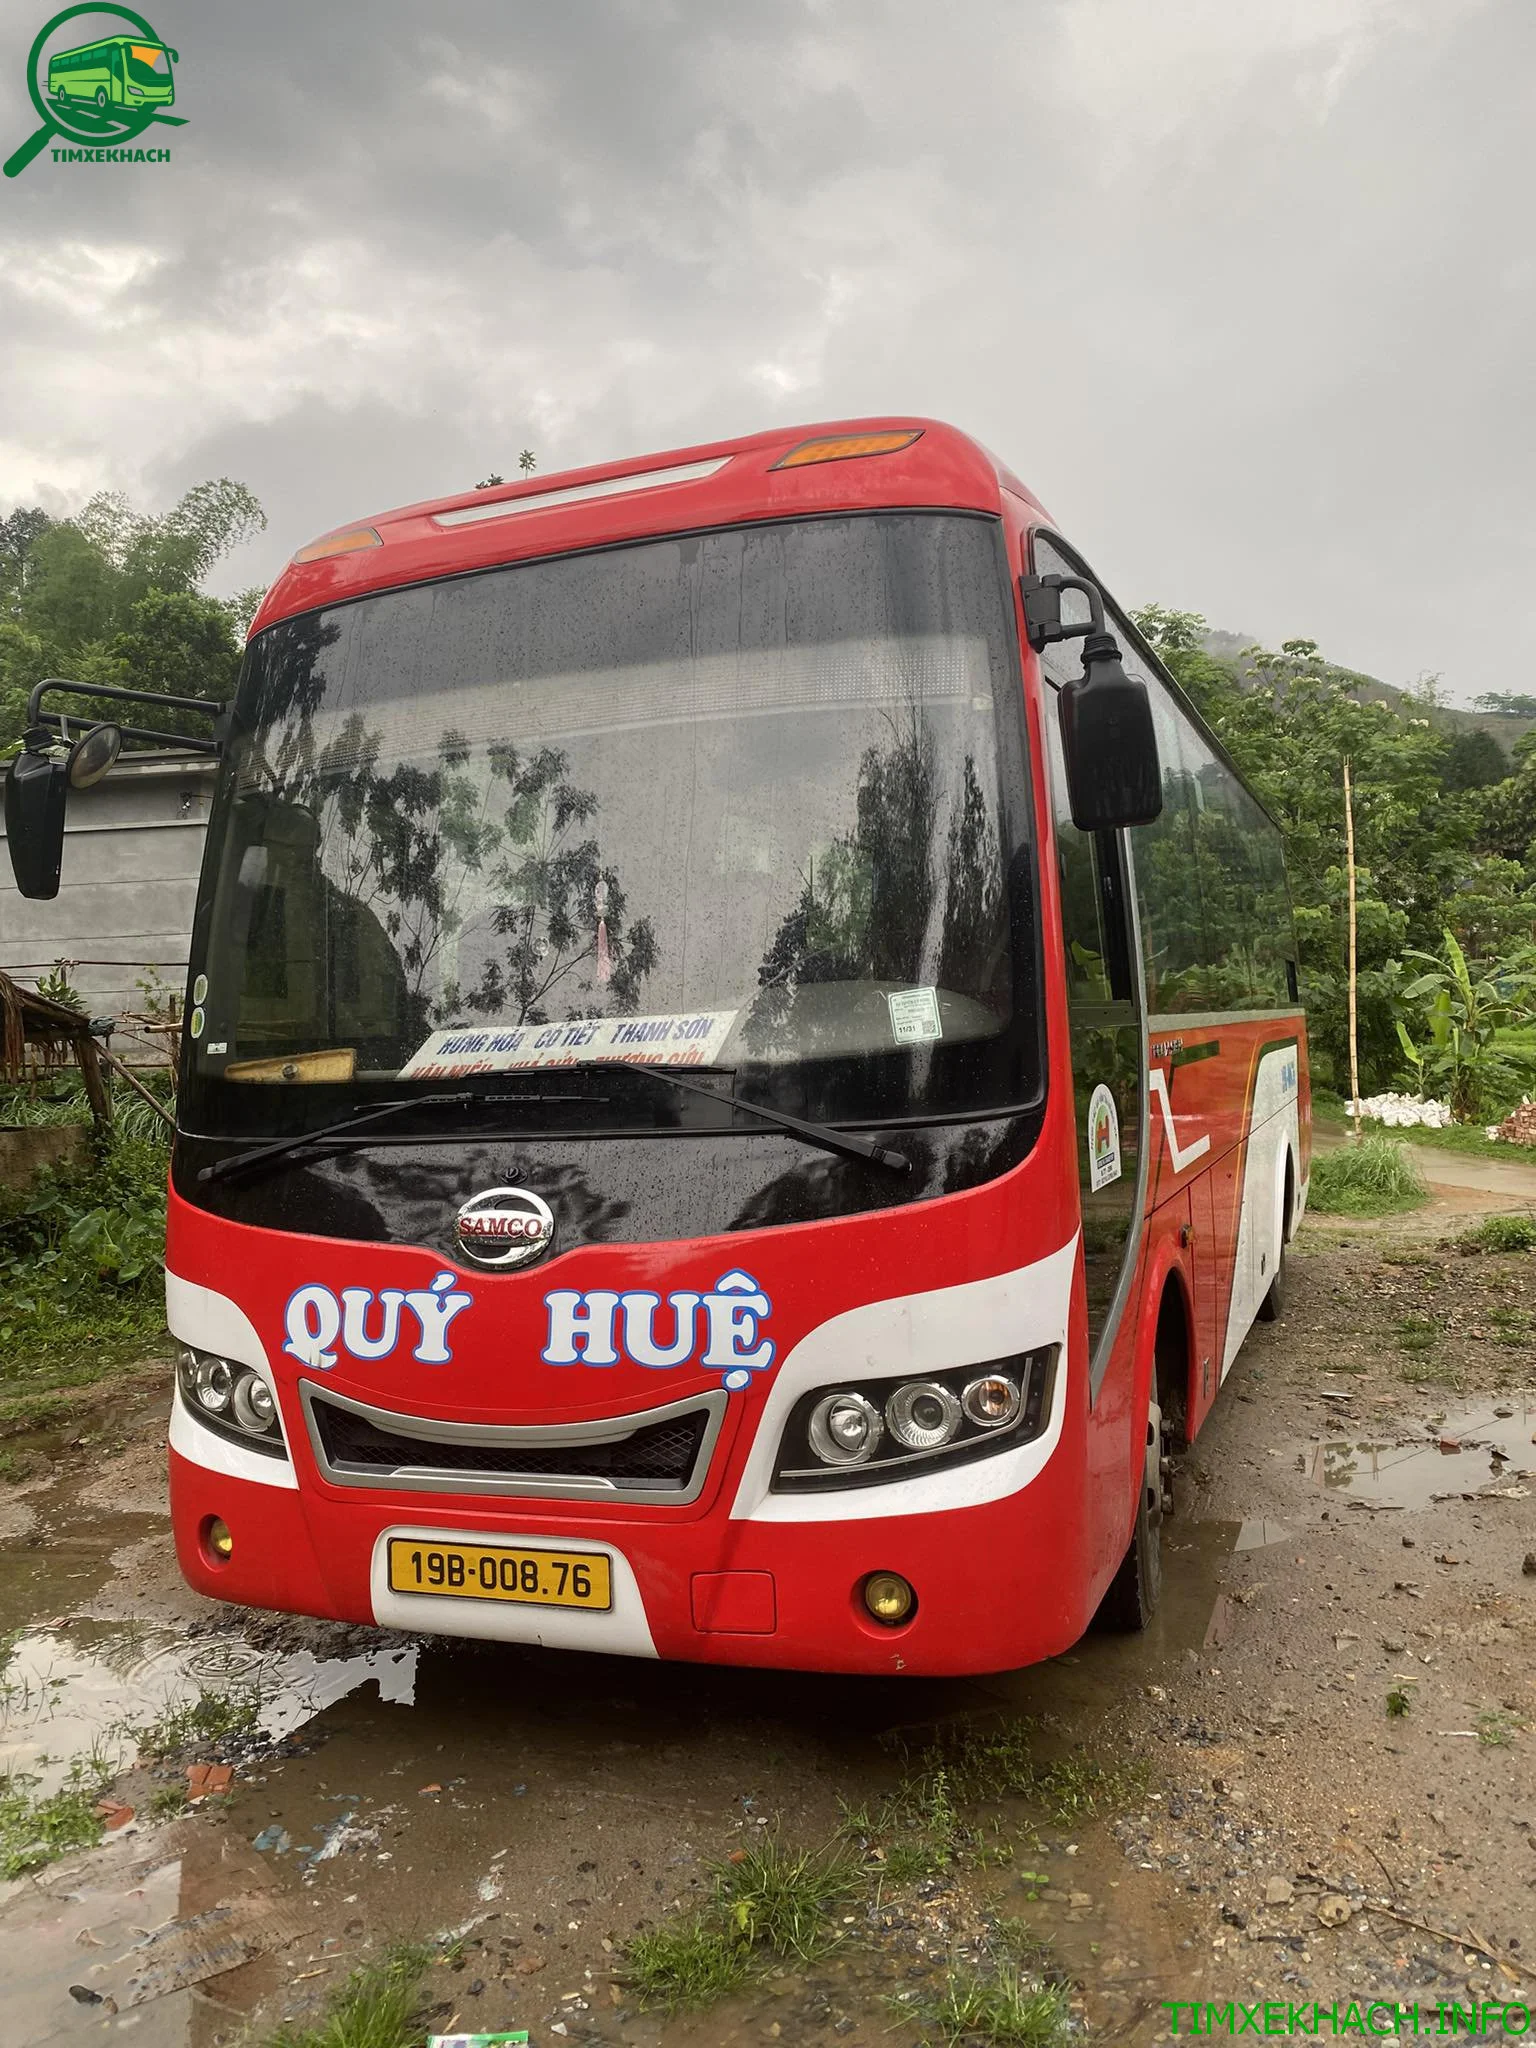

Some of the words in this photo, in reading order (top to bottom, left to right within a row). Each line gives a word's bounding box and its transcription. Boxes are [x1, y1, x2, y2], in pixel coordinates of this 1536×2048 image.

[610, 1020, 673, 1044] THANH
[458, 1217, 542, 1238] SAMCO
[283, 1271, 472, 1369] QUÝ
[541, 1269, 776, 1390] HUỆ
[411, 1552, 592, 1598] 19B-008.76
